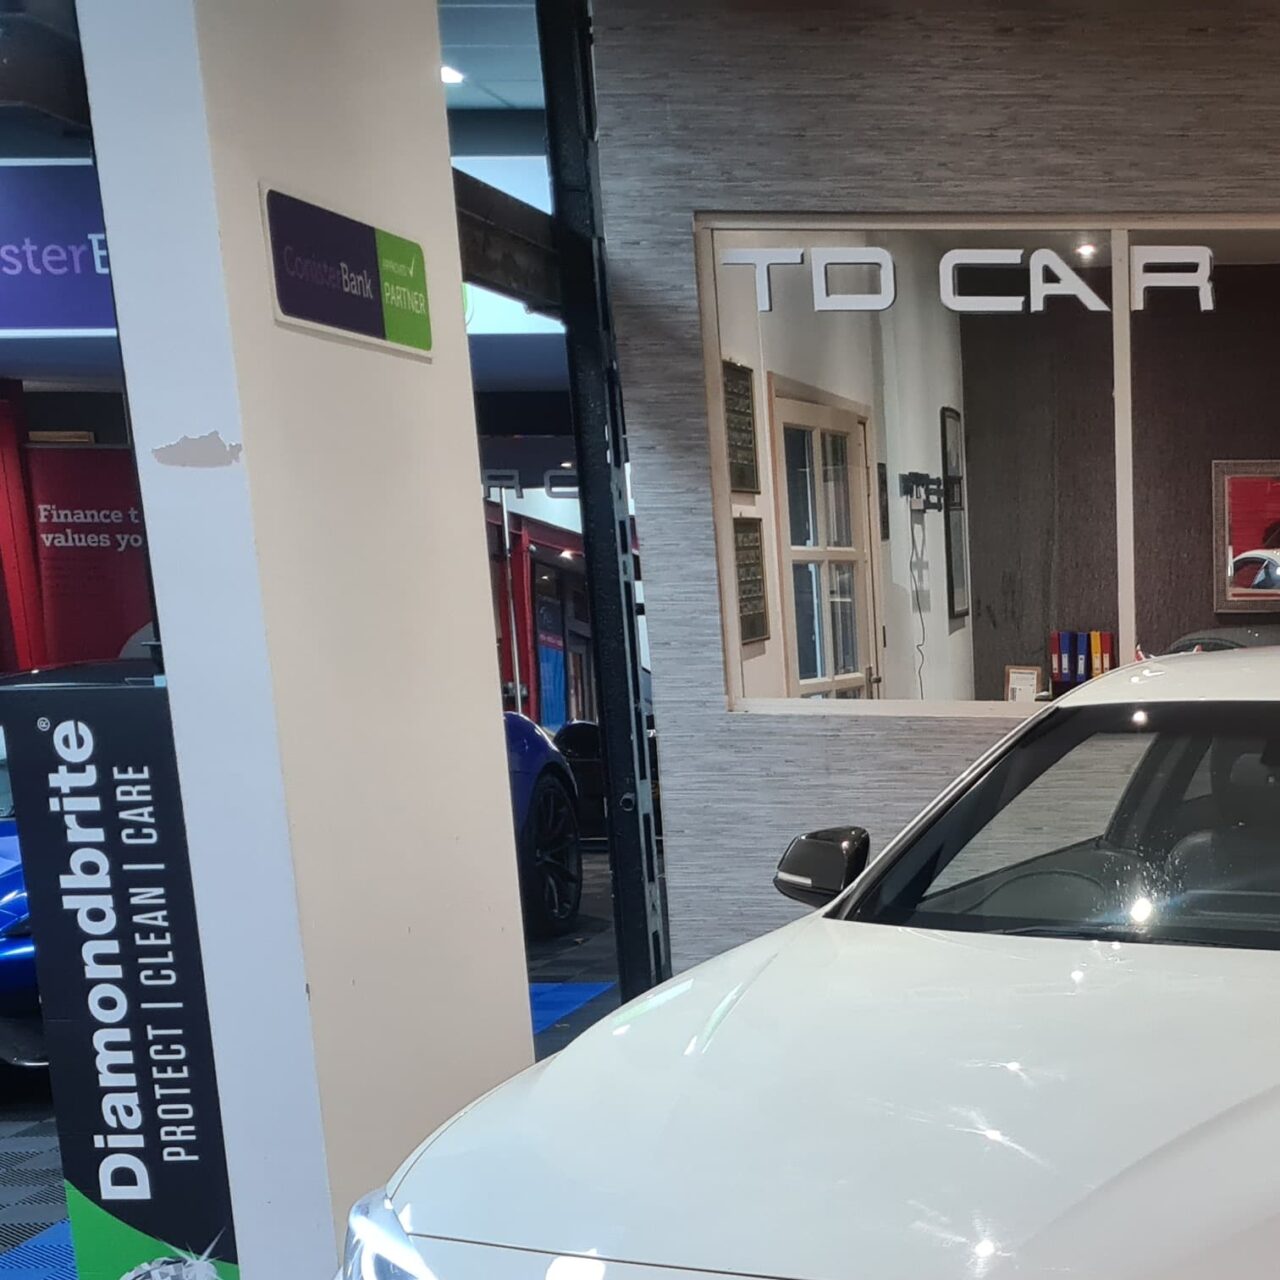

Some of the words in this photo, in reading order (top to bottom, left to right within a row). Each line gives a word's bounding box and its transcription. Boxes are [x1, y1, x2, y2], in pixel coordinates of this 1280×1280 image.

[383, 282, 426, 314] PARTNER
[721, 247, 896, 312] TD
[939, 246, 1215, 313] CAR
[38, 504, 122, 523] Finance
[41, 528, 111, 547] values
[112, 765, 158, 844] CARE
[48, 719, 152, 1200] Diamondbrite
[128, 887, 177, 986] CLEAN
[146, 1024, 199, 1162] PROTECT
